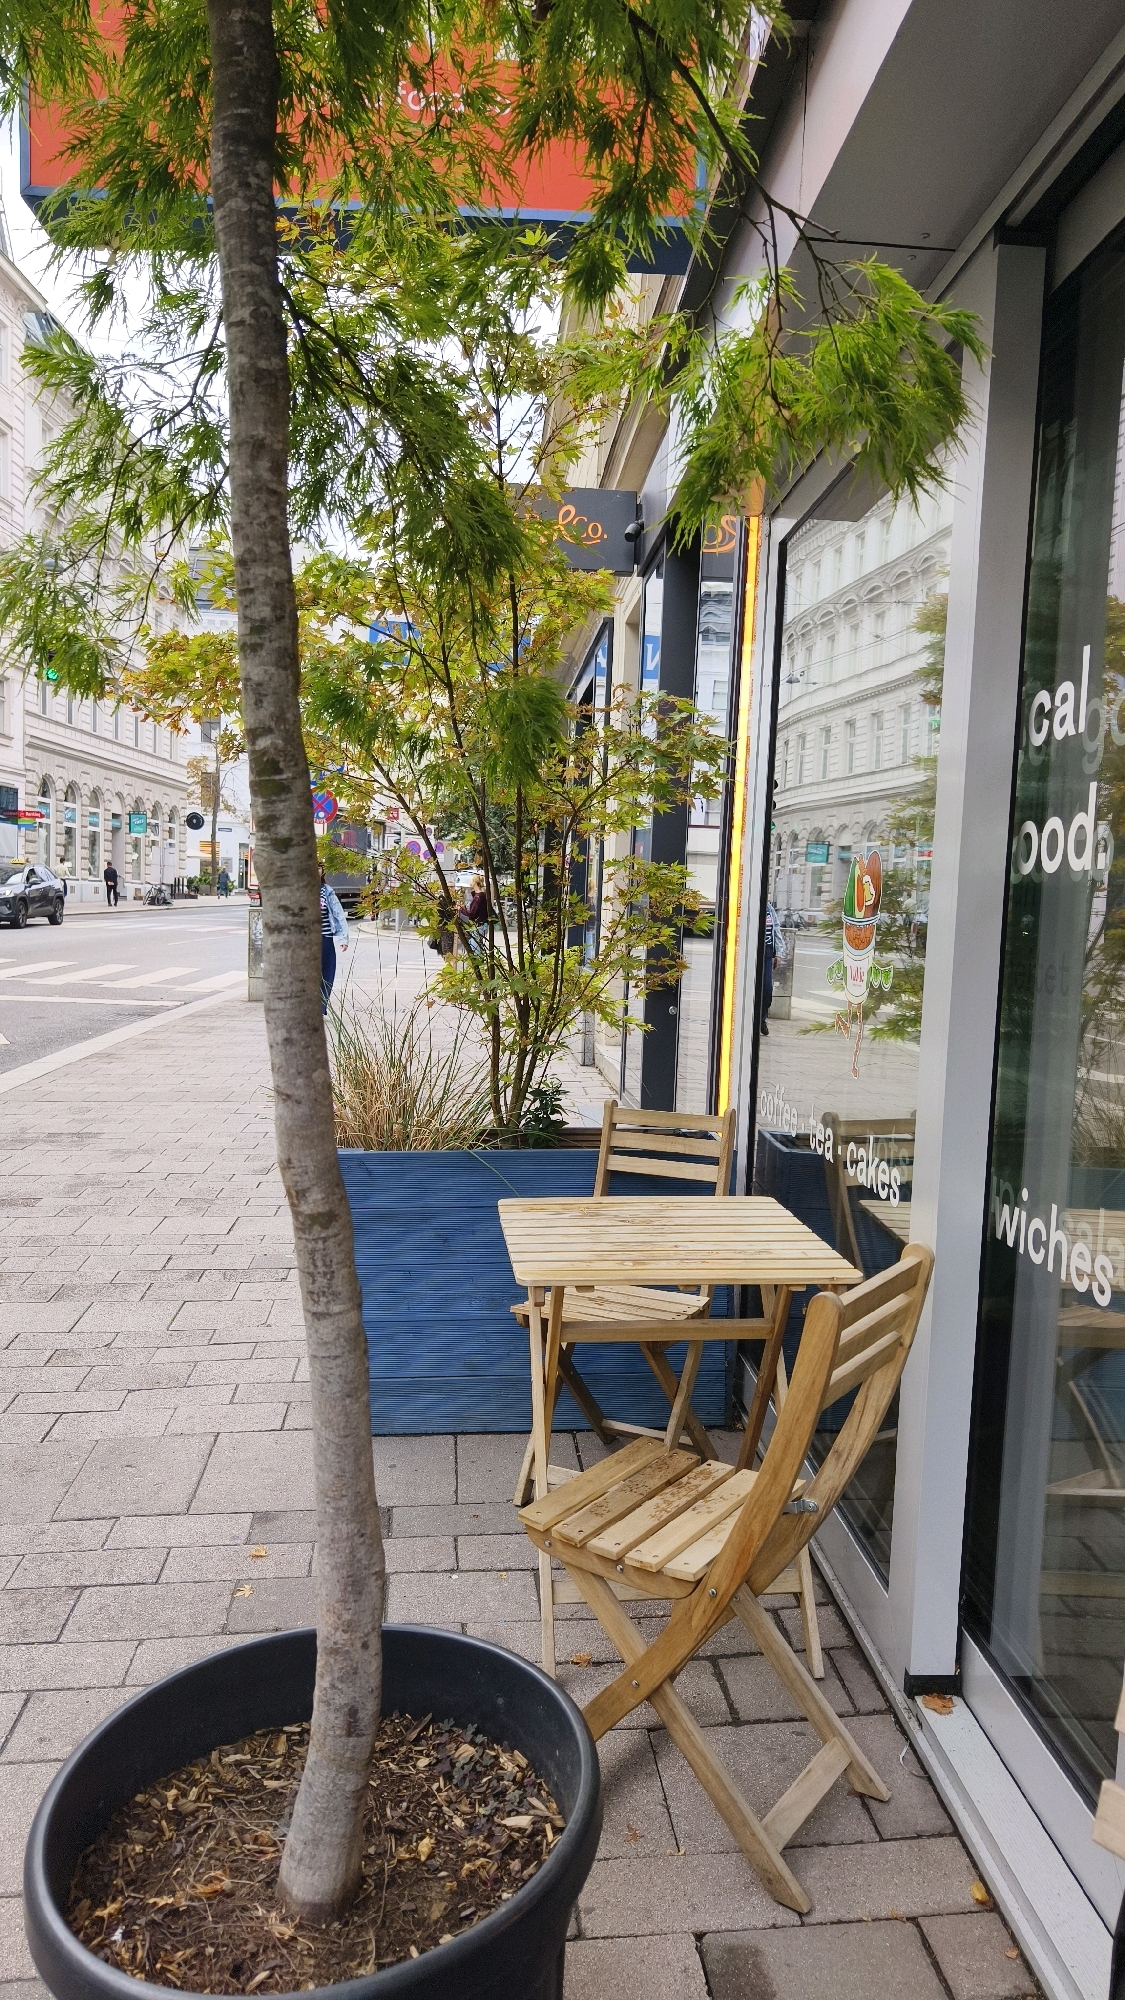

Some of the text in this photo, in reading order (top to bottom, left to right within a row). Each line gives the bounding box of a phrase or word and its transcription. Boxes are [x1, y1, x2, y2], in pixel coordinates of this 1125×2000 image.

[1029, 644, 1091, 747] cal
[760, 1084, 798, 1137] coffee
[809, 1103, 834, 1164] tea
[847, 1134, 901, 1208] cakes
[994, 1188, 1114, 1307] wiches
